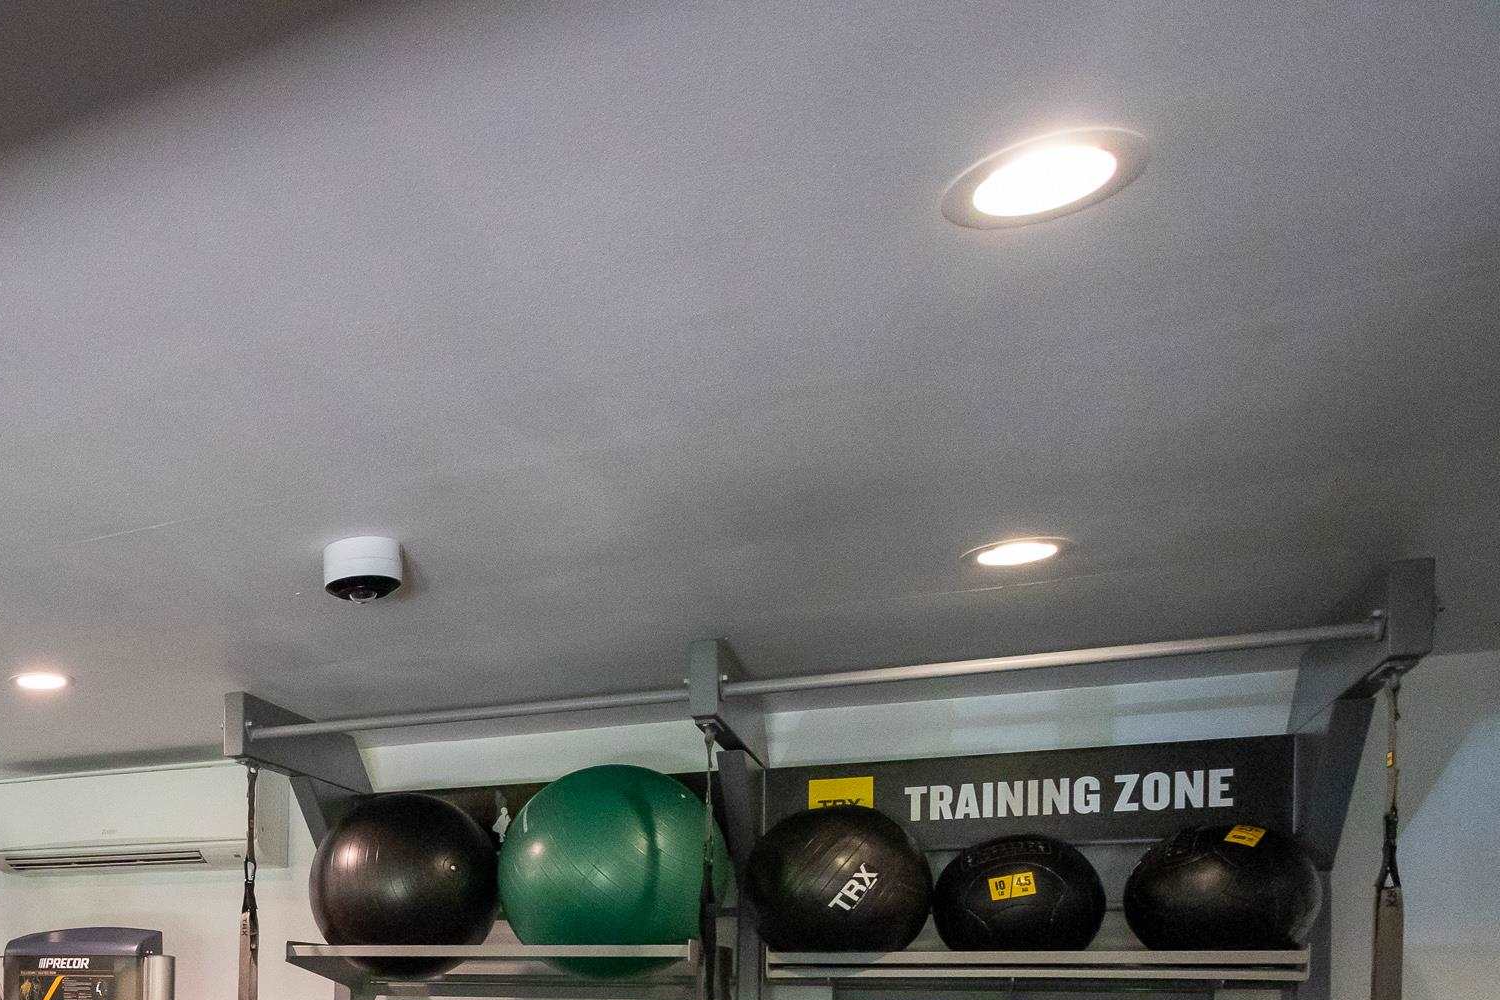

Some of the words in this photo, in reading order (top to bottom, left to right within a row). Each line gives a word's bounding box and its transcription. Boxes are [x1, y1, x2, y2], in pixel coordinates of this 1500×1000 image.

[904, 776, 1100, 821] TRAINING
[1113, 768, 1234, 812] ZONE
[828, 863, 878, 910] TRX
[45, 957, 90, 969] PRECOR
